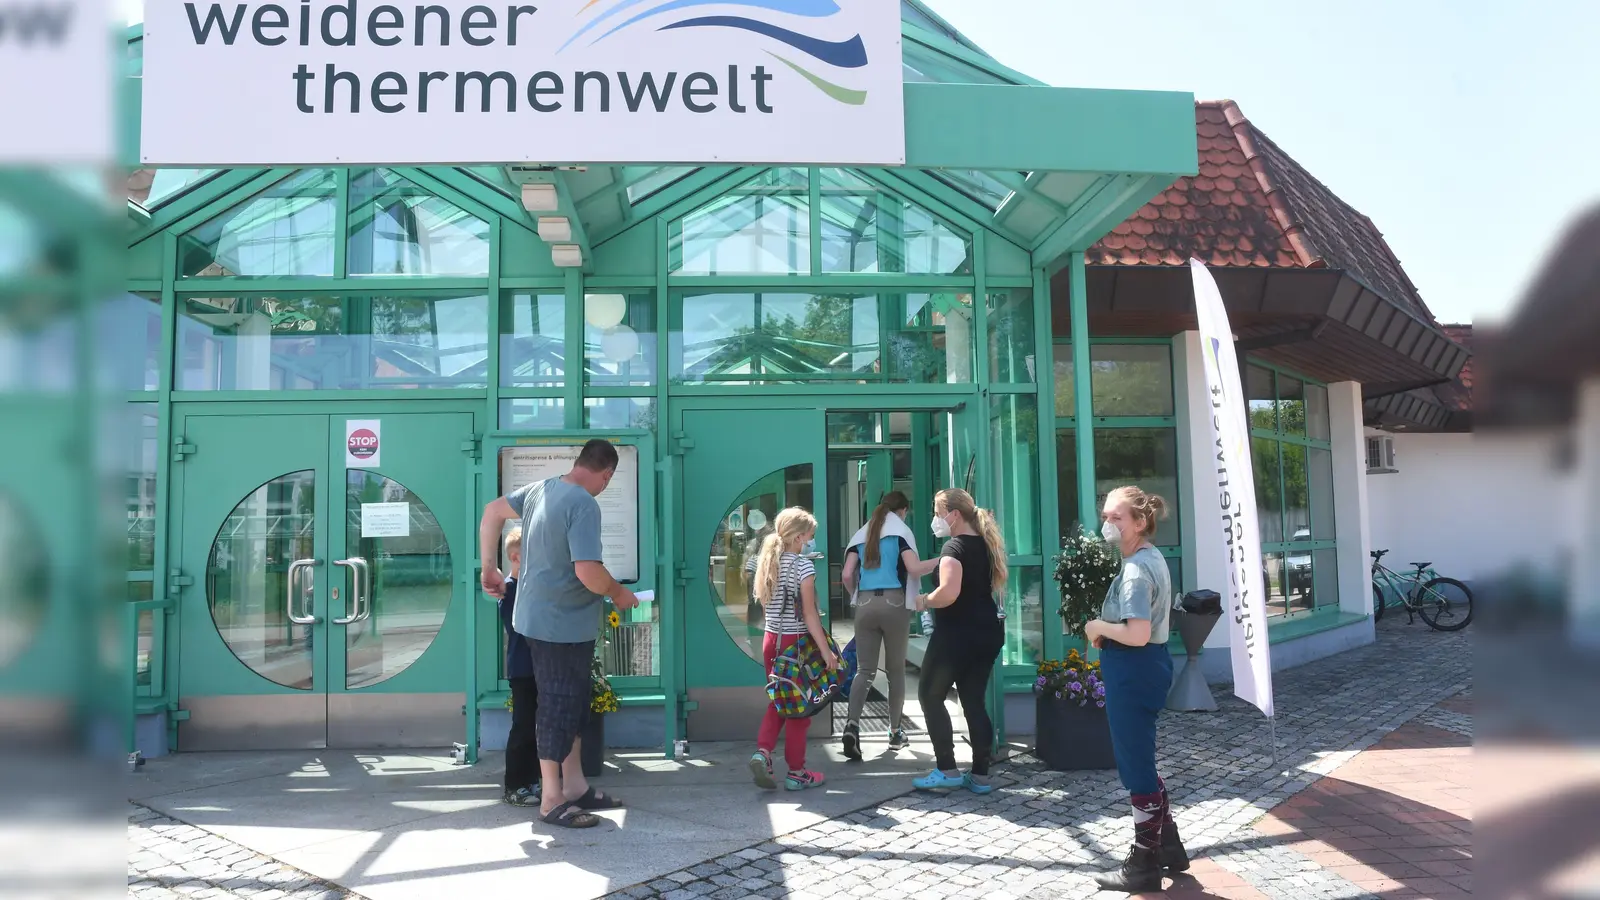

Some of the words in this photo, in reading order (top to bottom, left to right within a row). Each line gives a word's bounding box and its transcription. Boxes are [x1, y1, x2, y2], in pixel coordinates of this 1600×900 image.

[183, 0, 538, 47] weidener
[292, 63, 774, 114] thermenwelt
[349, 436, 377, 446] STOP
